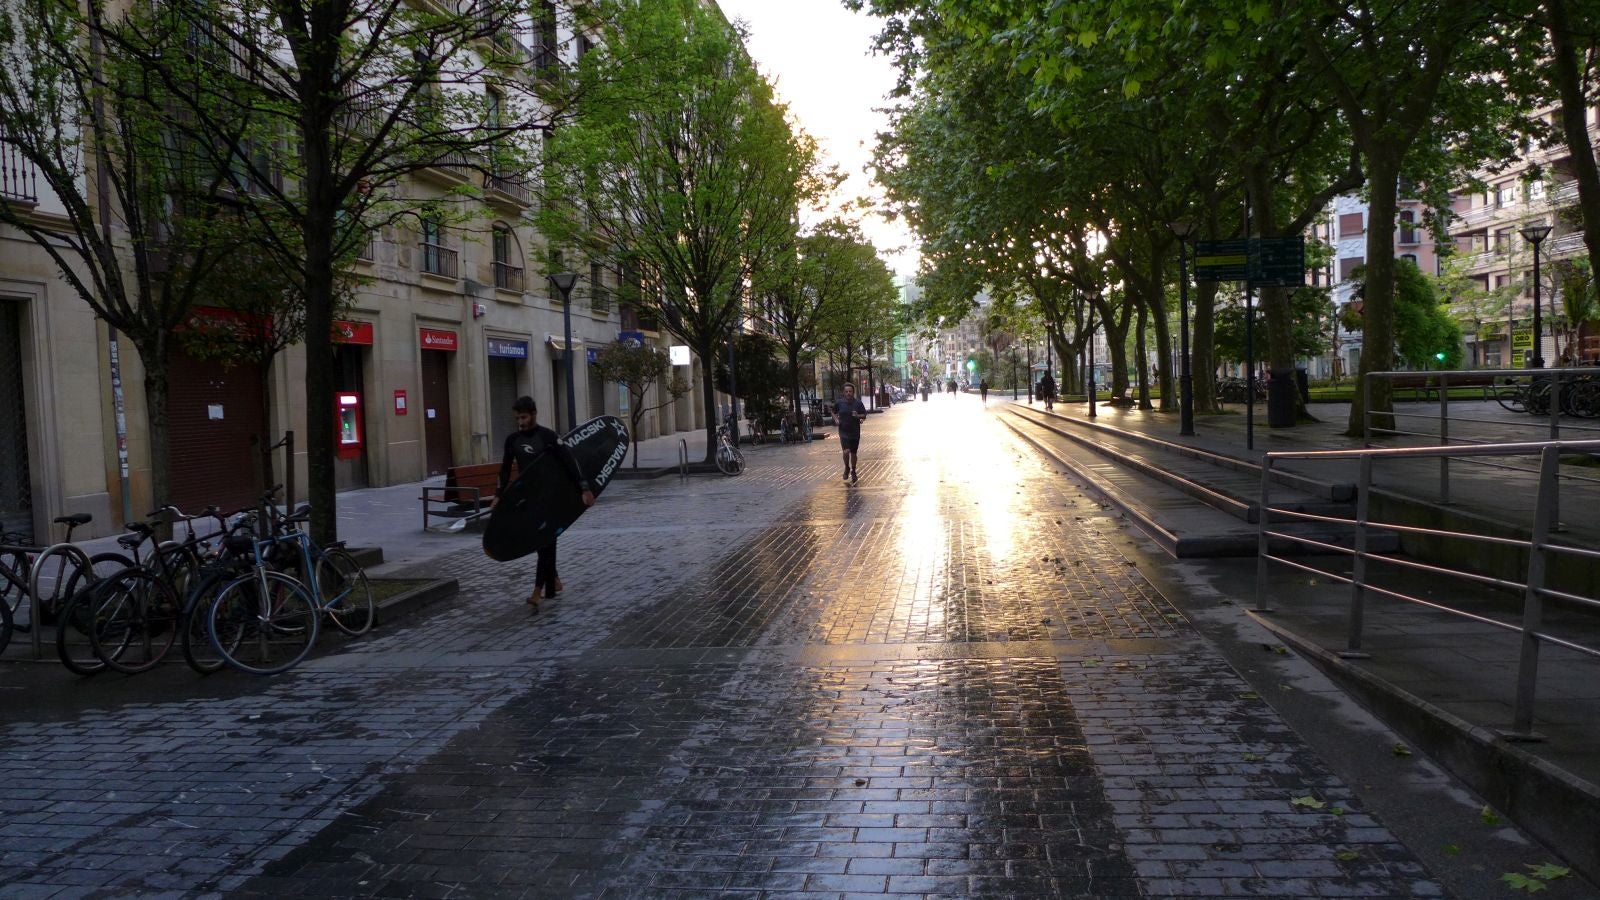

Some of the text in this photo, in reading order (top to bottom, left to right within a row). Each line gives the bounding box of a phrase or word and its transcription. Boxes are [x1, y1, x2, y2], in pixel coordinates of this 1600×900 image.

[431, 335, 454, 344] Santander
[499, 343, 525, 355] turismoa
[564, 419, 606, 448] MACSKI
[595, 441, 627, 486] MACSKI
